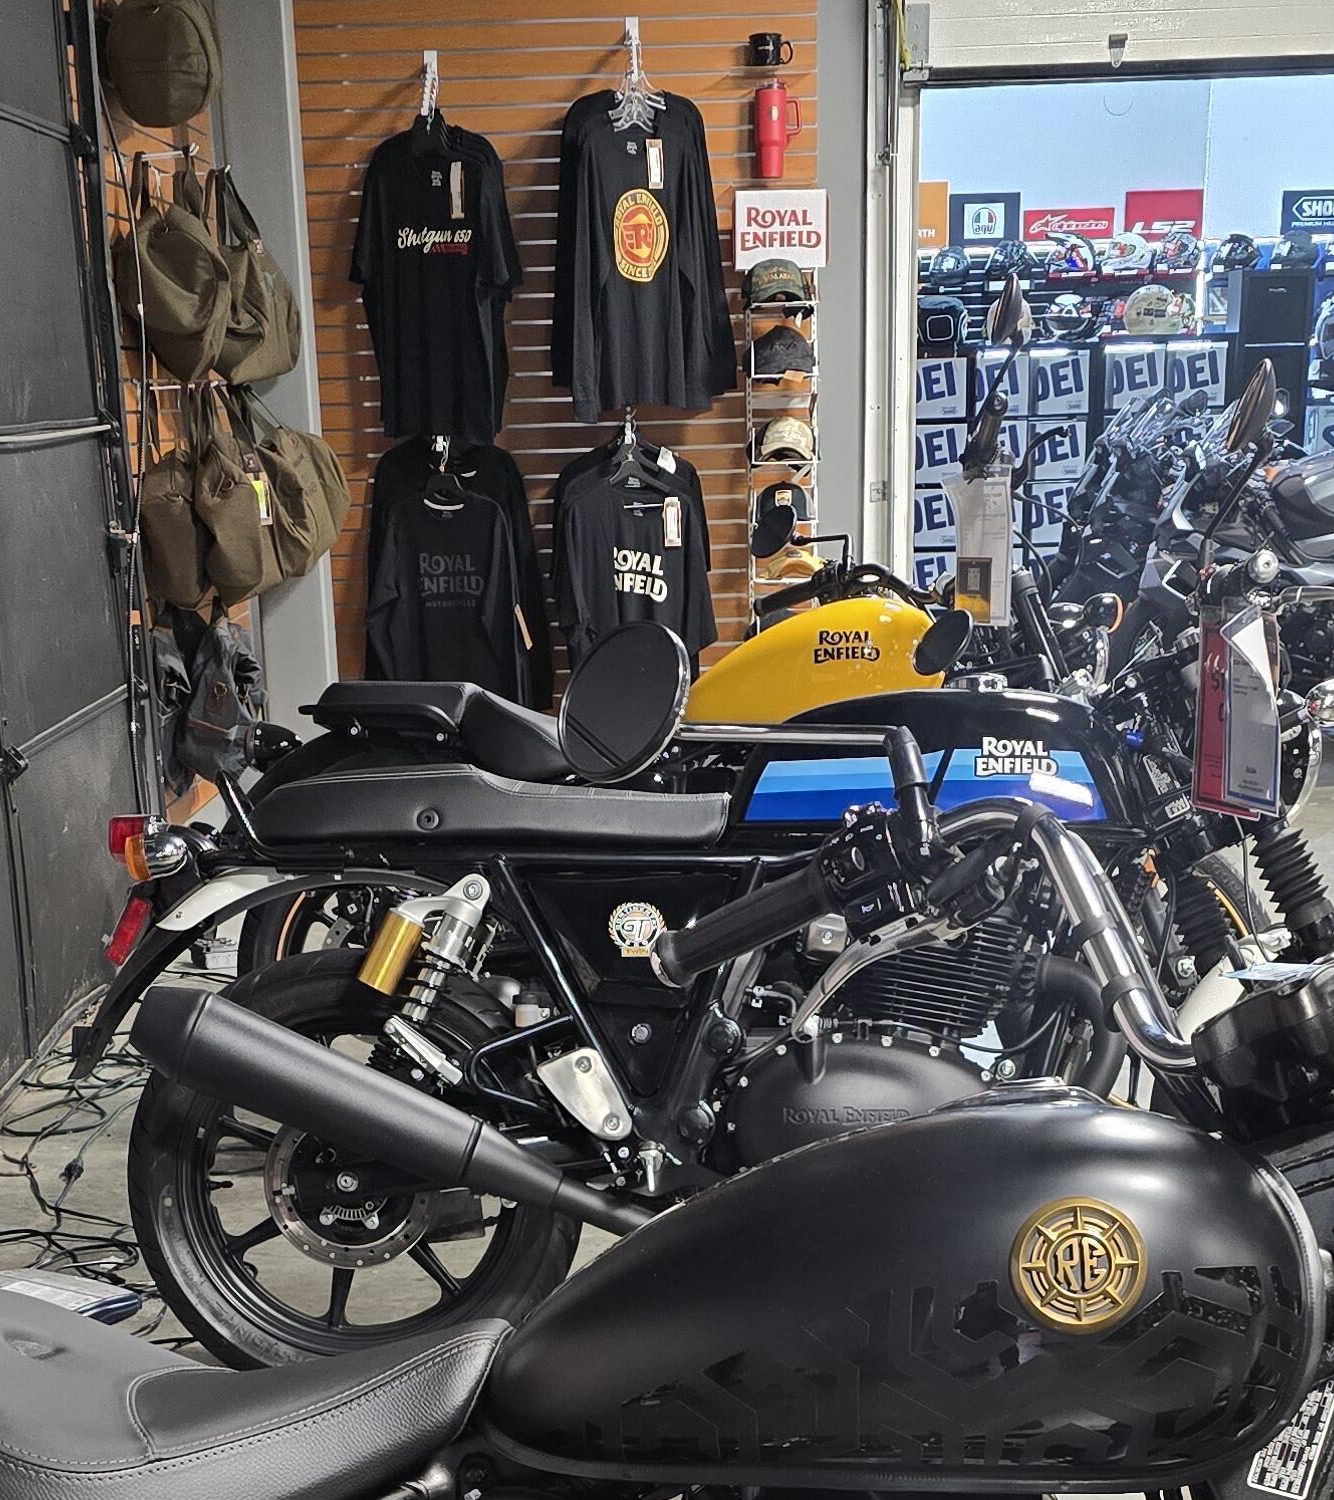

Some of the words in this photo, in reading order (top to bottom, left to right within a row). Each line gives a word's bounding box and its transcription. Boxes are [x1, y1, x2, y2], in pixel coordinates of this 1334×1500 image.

[746, 206, 813, 229] ROYAL
[1132, 220, 1196, 234] LS2
[454, 229, 472, 243] 650
[740, 230, 822, 252] ENFIELD
[419, 553, 475, 574] ROYAL
[819, 630, 870, 646] ROYAL
[814, 646, 880, 664] ENFIELD
[982, 736, 1048, 757] ROYAL
[975, 757, 1058, 777] ENFIELD
[625, 948, 649, 956] TWIN
[782, 1107, 839, 1125] ROYAL
[843, 1106, 912, 1126] ENFIELD
